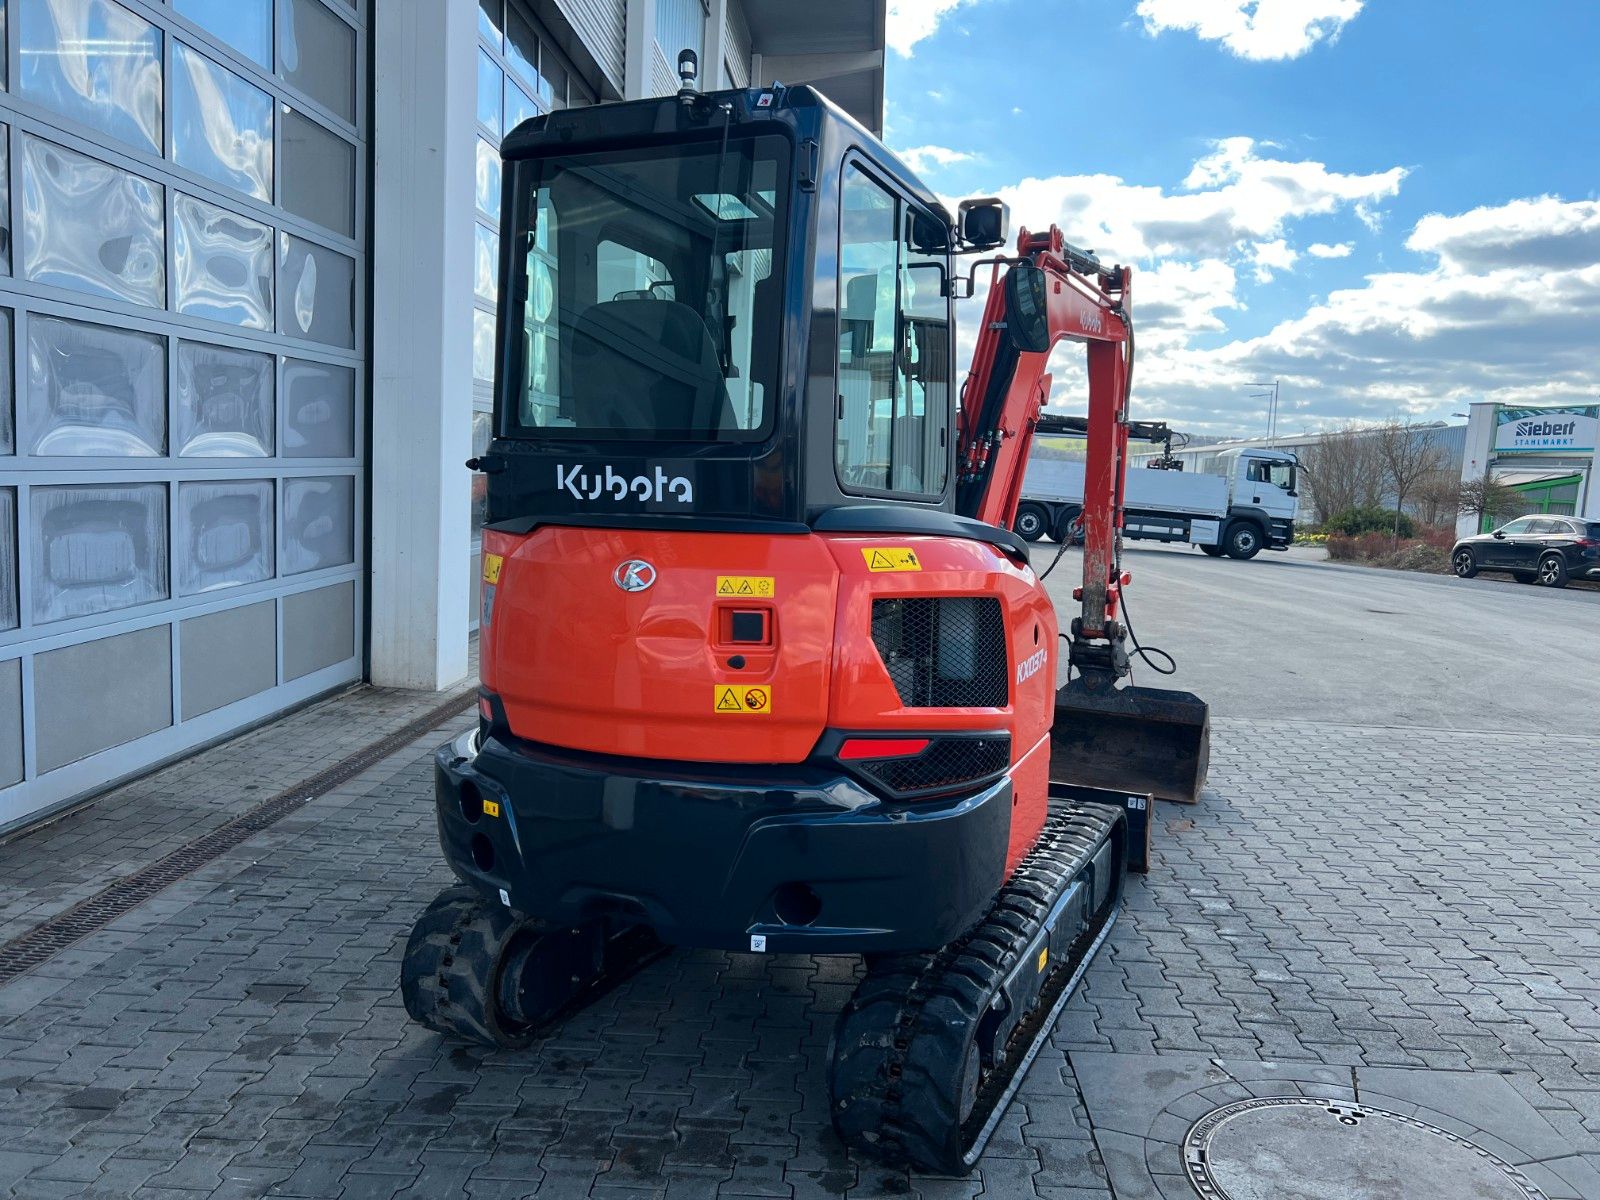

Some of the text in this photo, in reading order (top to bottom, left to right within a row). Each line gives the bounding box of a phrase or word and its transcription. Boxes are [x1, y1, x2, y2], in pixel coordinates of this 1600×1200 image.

[1516, 421, 1576, 436] Siebert
[1515, 438, 1575, 446] STAHLMARKT
[556, 464, 693, 503] Kubota
